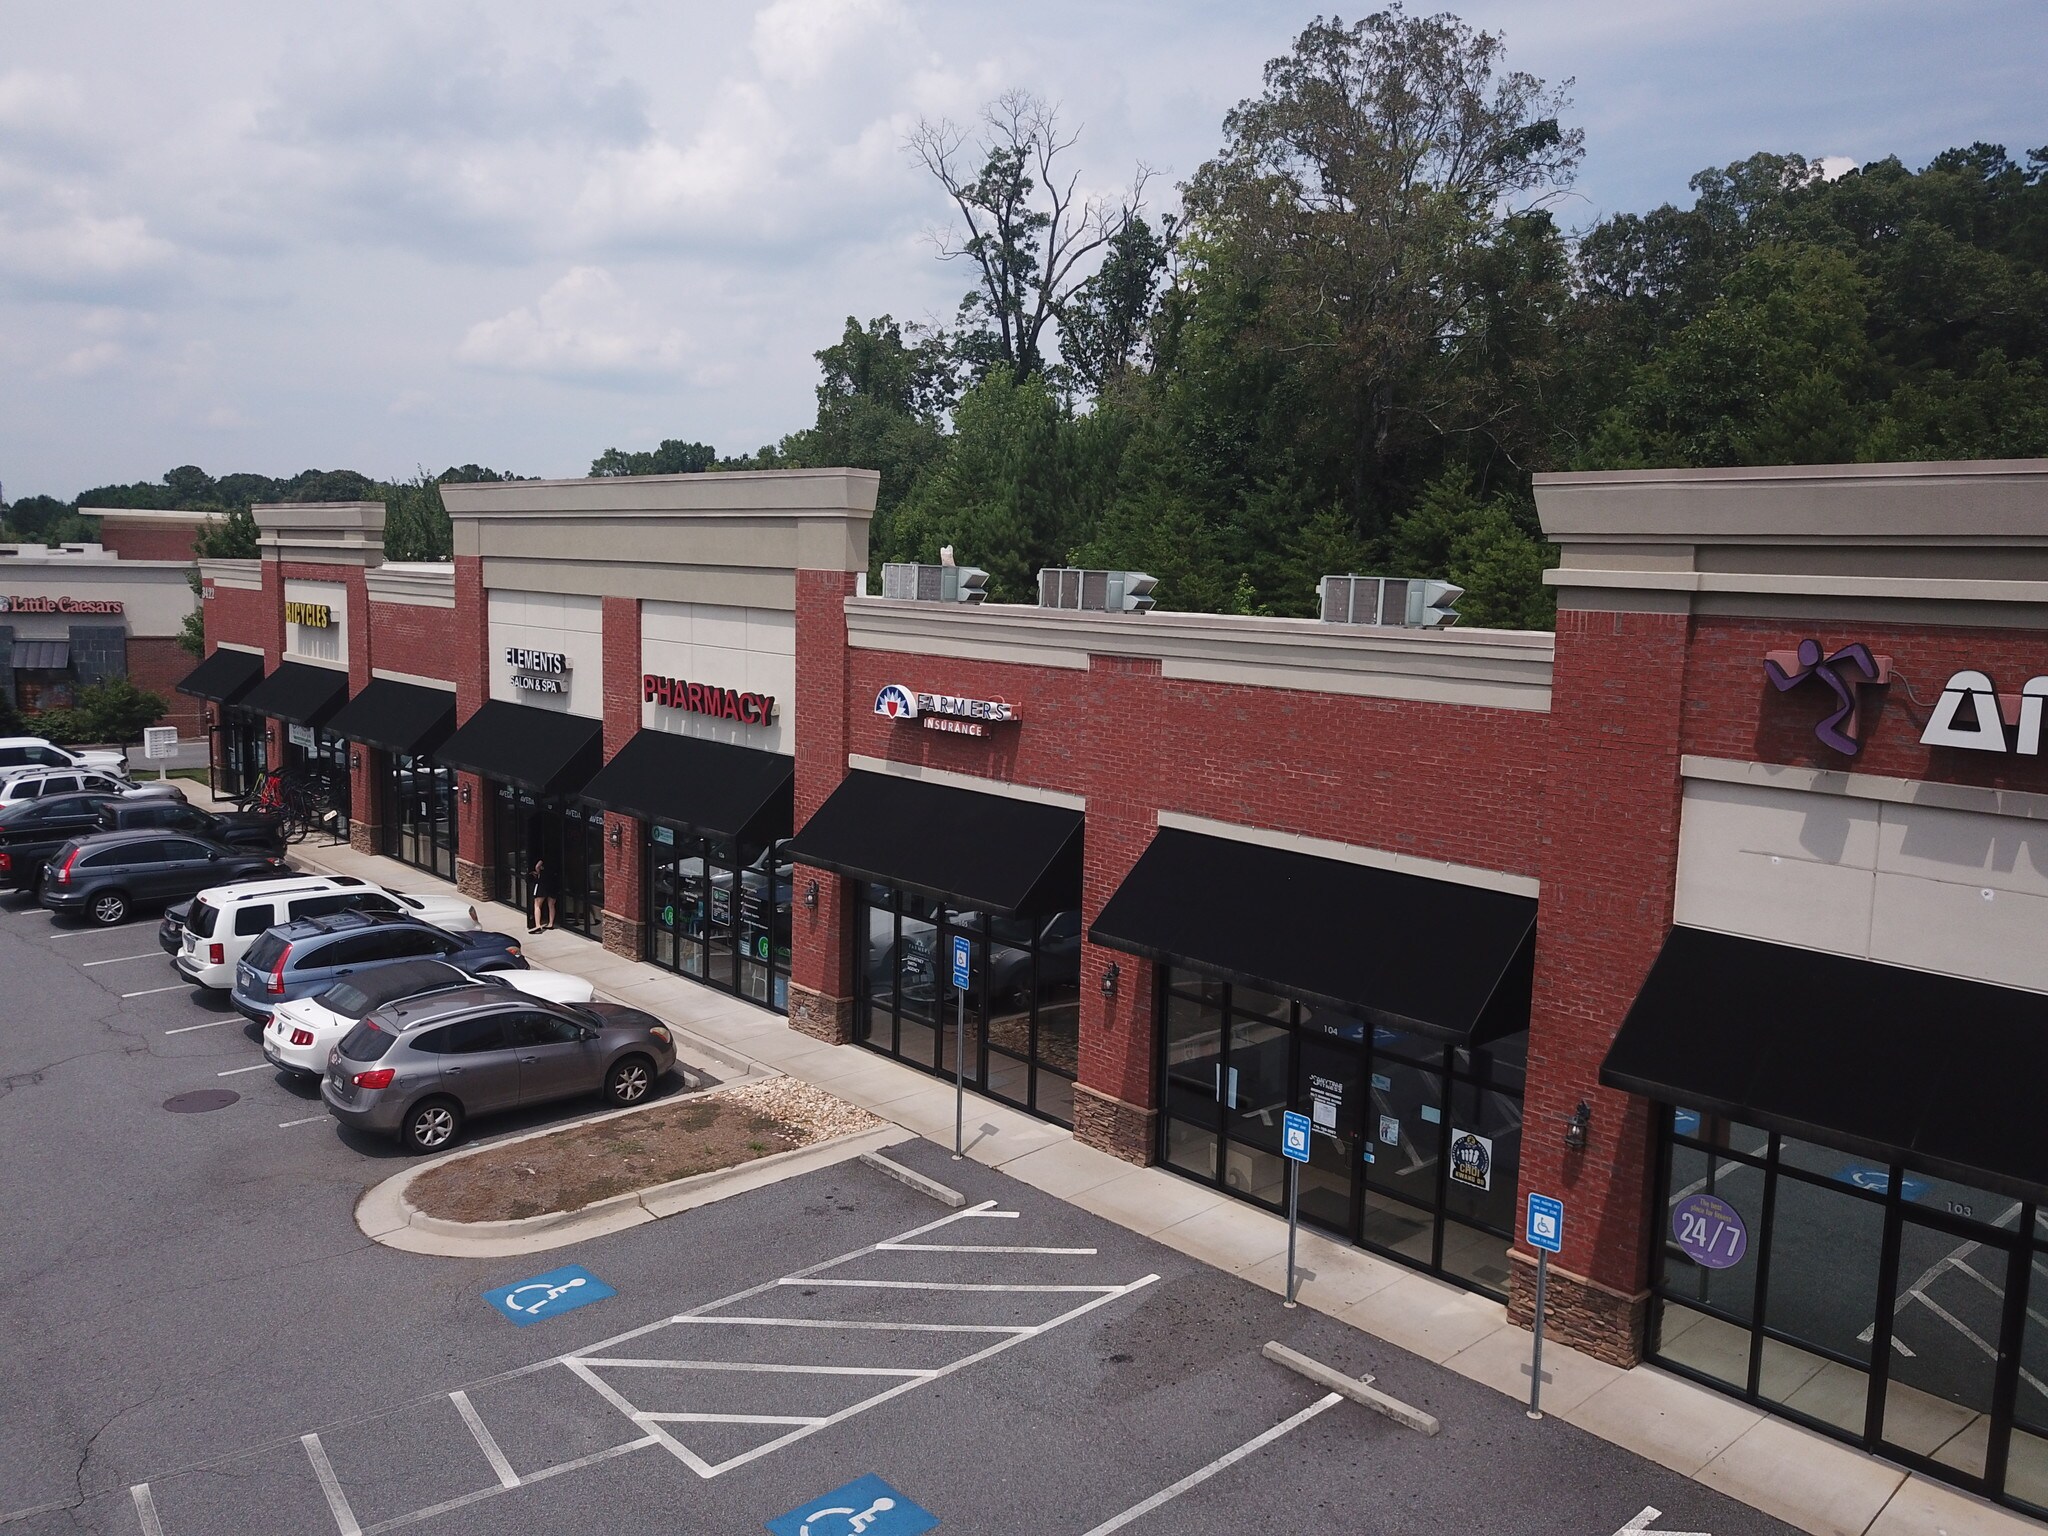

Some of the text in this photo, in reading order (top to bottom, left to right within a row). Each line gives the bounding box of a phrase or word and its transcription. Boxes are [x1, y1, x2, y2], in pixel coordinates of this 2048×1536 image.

[201, 586, 215, 600] 3422
[9, 595, 122, 615] Little Caesars
[285, 602, 328, 629] BICYCLES
[505, 647, 563, 674] ELEMENTS
[509, 675, 557, 694] SALON & SPA
[643, 674, 774, 727] PHARMACY
[917, 693, 1008, 721] FARMERS
[923, 718, 982, 737] INSURANCE
[565, 808, 581, 820] AVEDA
[589, 815, 604, 826] AVED
[1323, 1024, 1338, 1036] 104
[1459, 1163, 1481, 1178] CHOI
[1700, 1198, 1710, 1207] The
[1946, 1201, 1972, 1217] 103
[1680, 1212, 1741, 1257] 24/7
